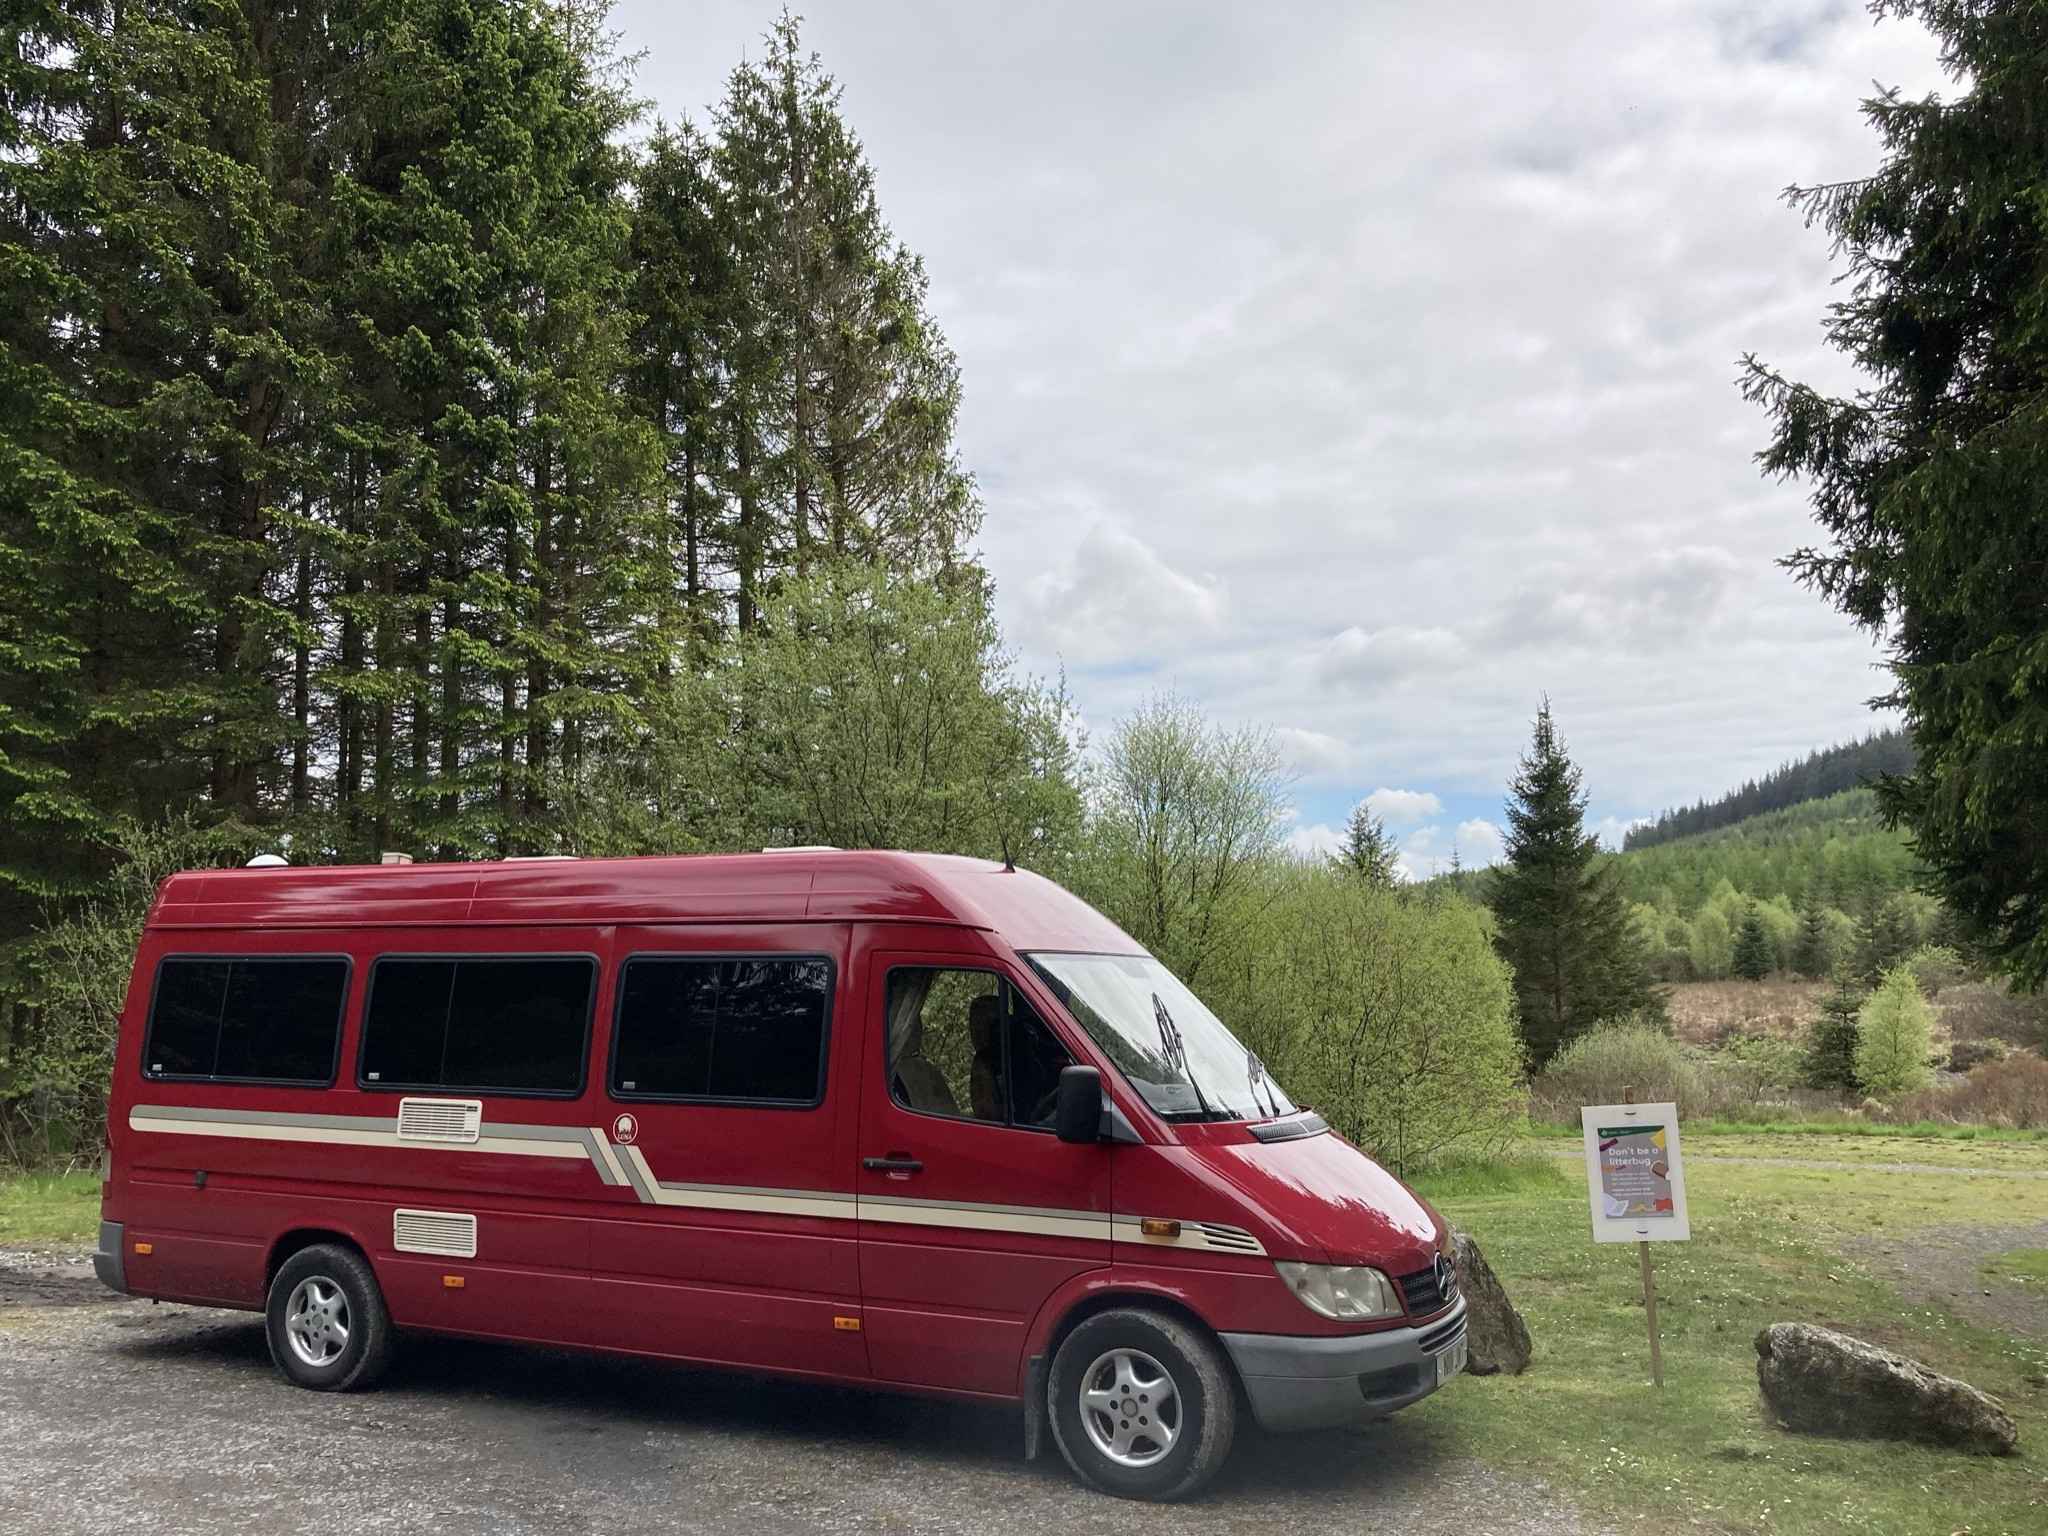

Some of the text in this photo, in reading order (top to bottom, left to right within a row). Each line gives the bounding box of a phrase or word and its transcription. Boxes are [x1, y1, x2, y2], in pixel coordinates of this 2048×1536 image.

[1608, 1146, 1634, 1156] Don't
[1637, 1147, 1649, 1155] be
[1609, 1157, 1651, 1166] litterbug
